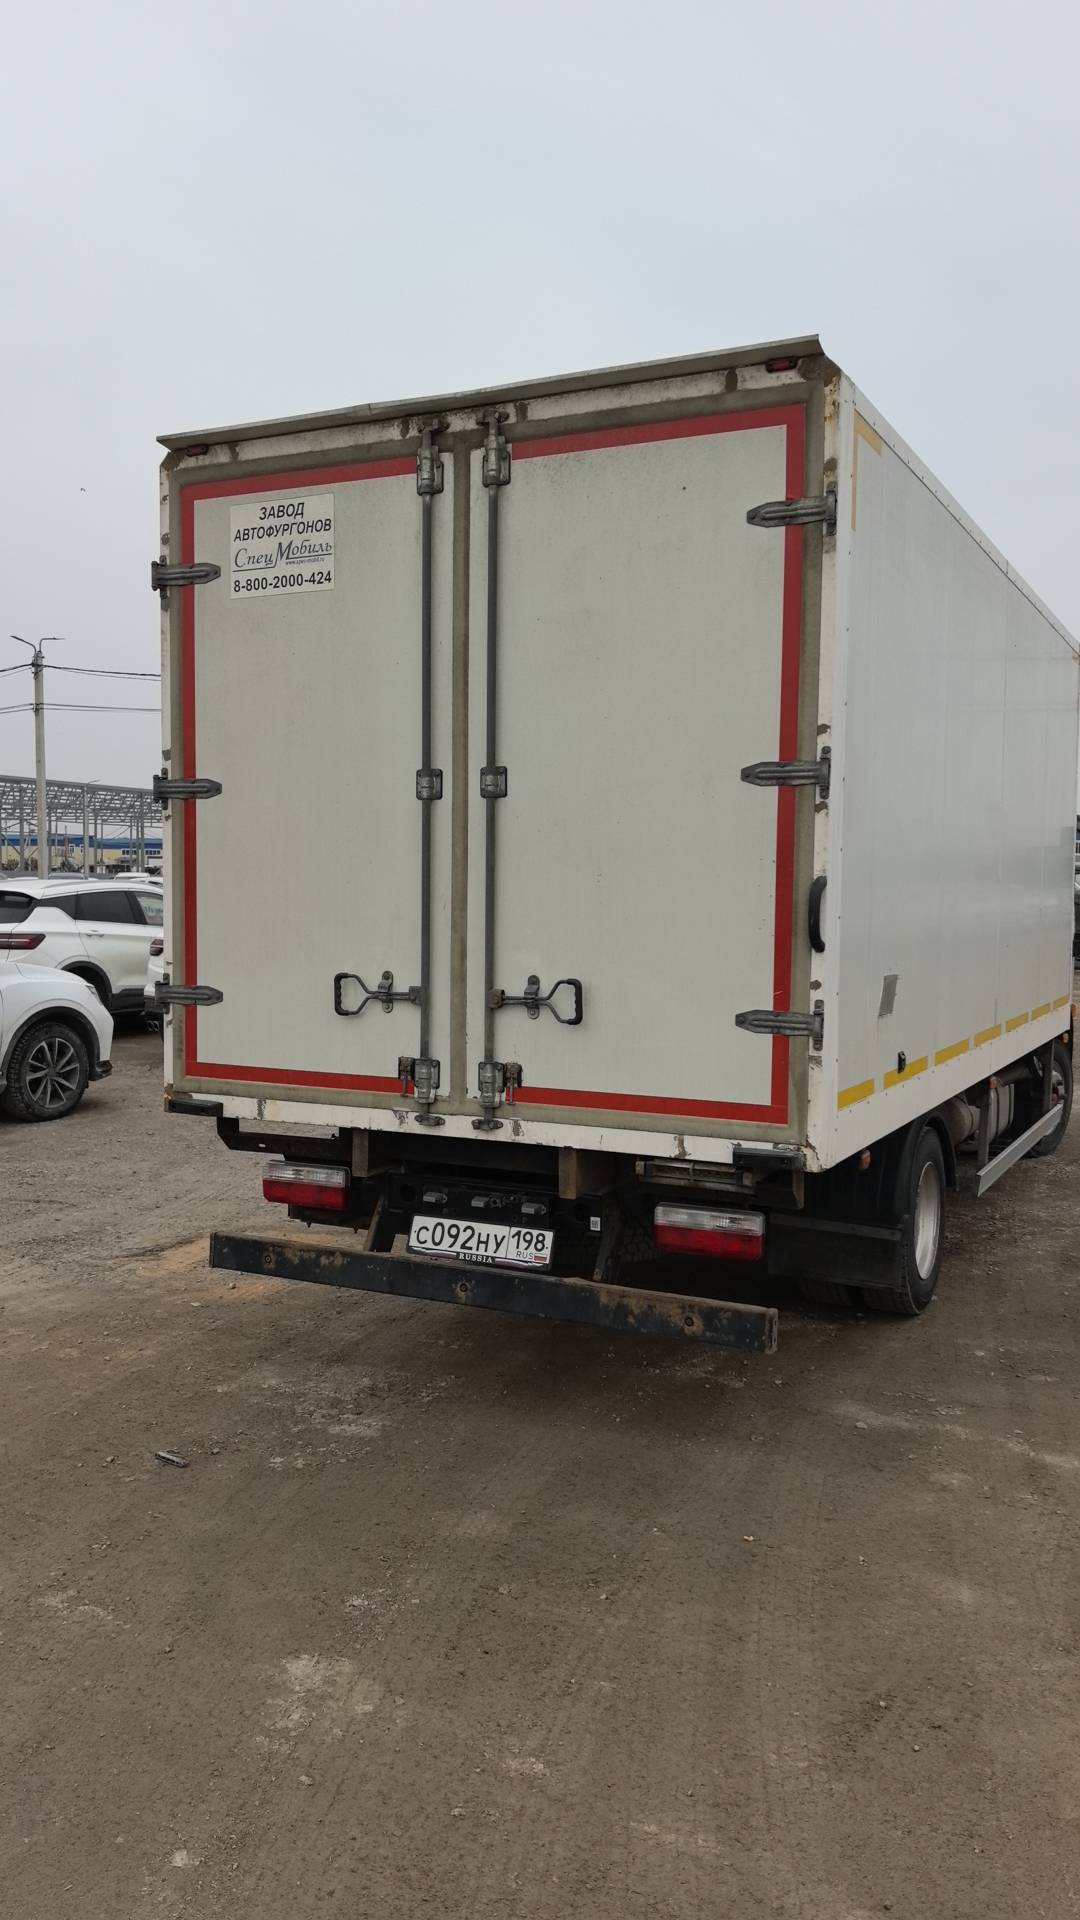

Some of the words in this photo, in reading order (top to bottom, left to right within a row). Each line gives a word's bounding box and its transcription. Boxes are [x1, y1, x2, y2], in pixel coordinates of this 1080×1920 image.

[259, 502, 305, 520] ЗАВОД
[233, 518, 332, 542] АВТОФУРГОНОВ
[233, 570, 332, 593] 8-800-2000-424
[511, 1230, 546, 1252] 198
[459, 1252, 493, 1264] RUSSIA
[516, 1251, 534, 1260] RUS
